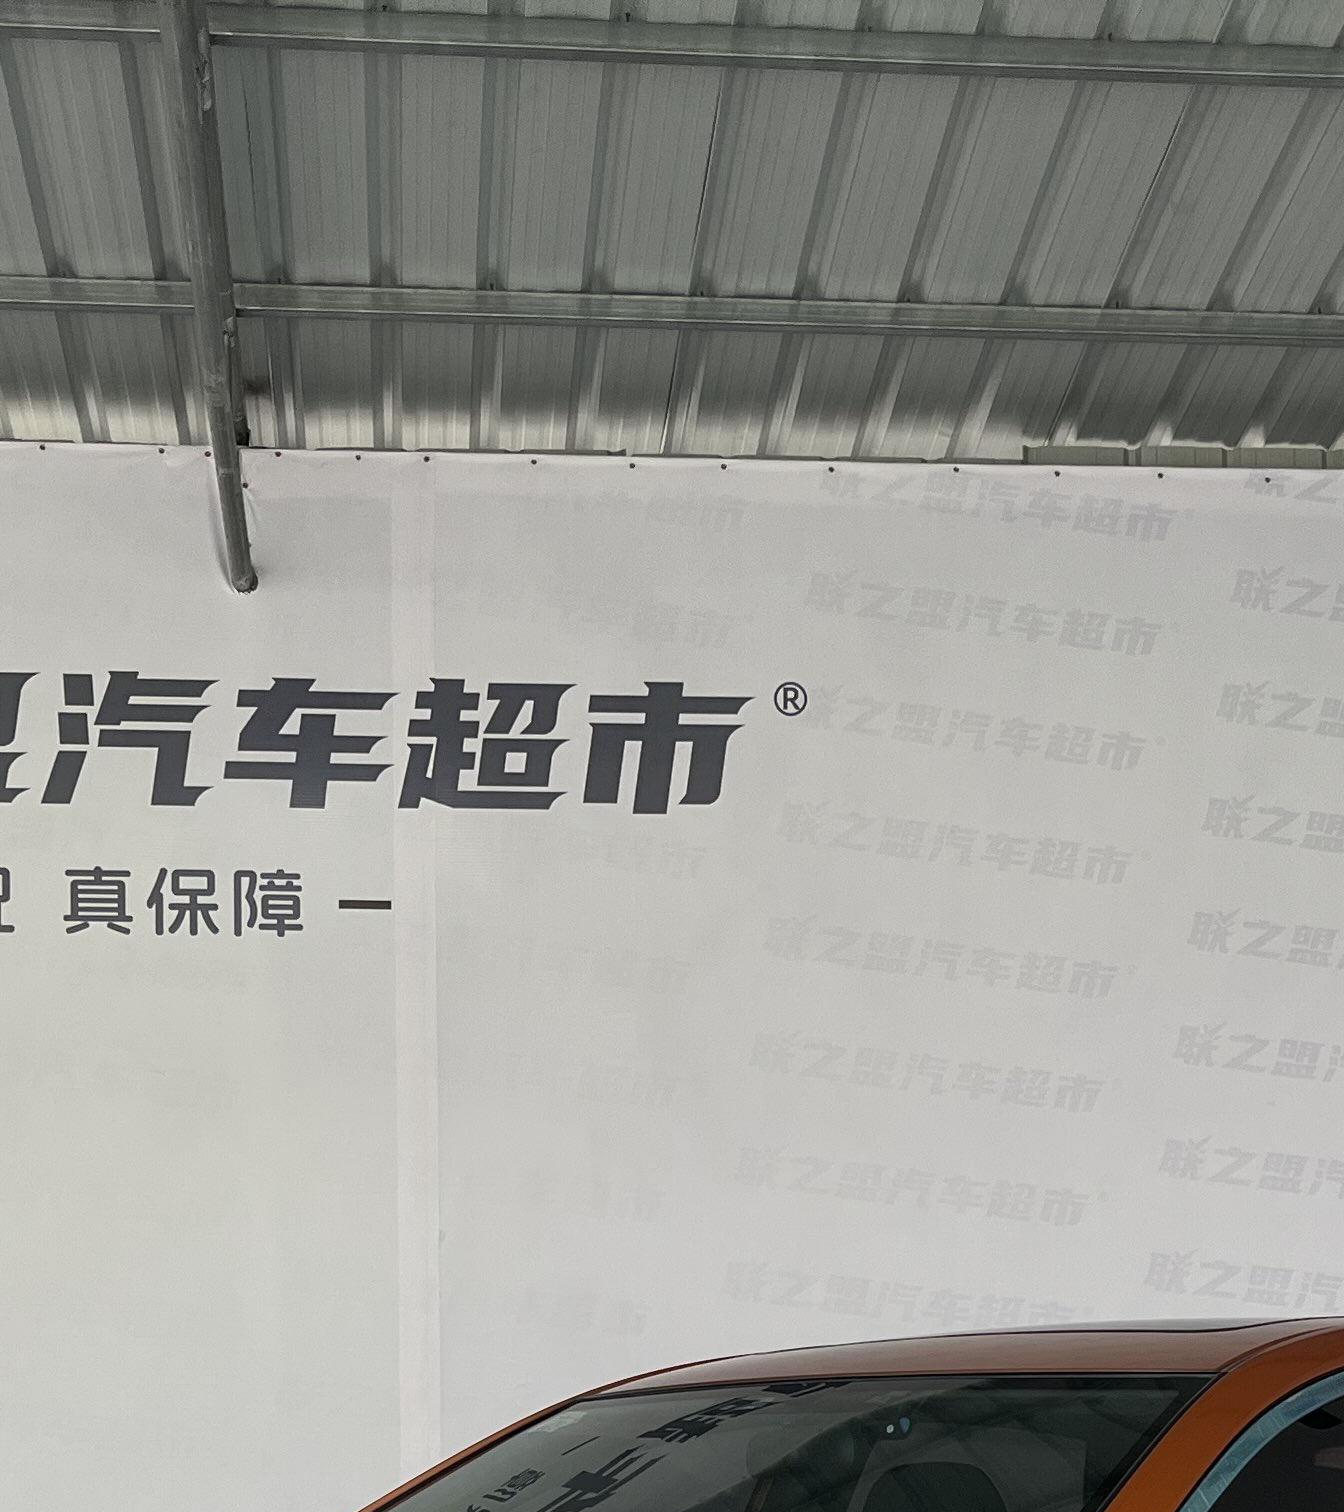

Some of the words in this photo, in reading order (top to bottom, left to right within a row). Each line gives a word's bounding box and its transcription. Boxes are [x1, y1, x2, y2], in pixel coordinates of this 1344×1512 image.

[806, 570, 1161, 655] 联之盟汽车超市
[776, 799, 1132, 885] 联之盟汽车超市
[62, 863, 306, 940] 真保障
[763, 916, 1117, 998] 联之盟汽车超市
[748, 1030, 1104, 1112] 联之盟汽车超市
[734, 1144, 1088, 1226] 联之盟汽车超市
